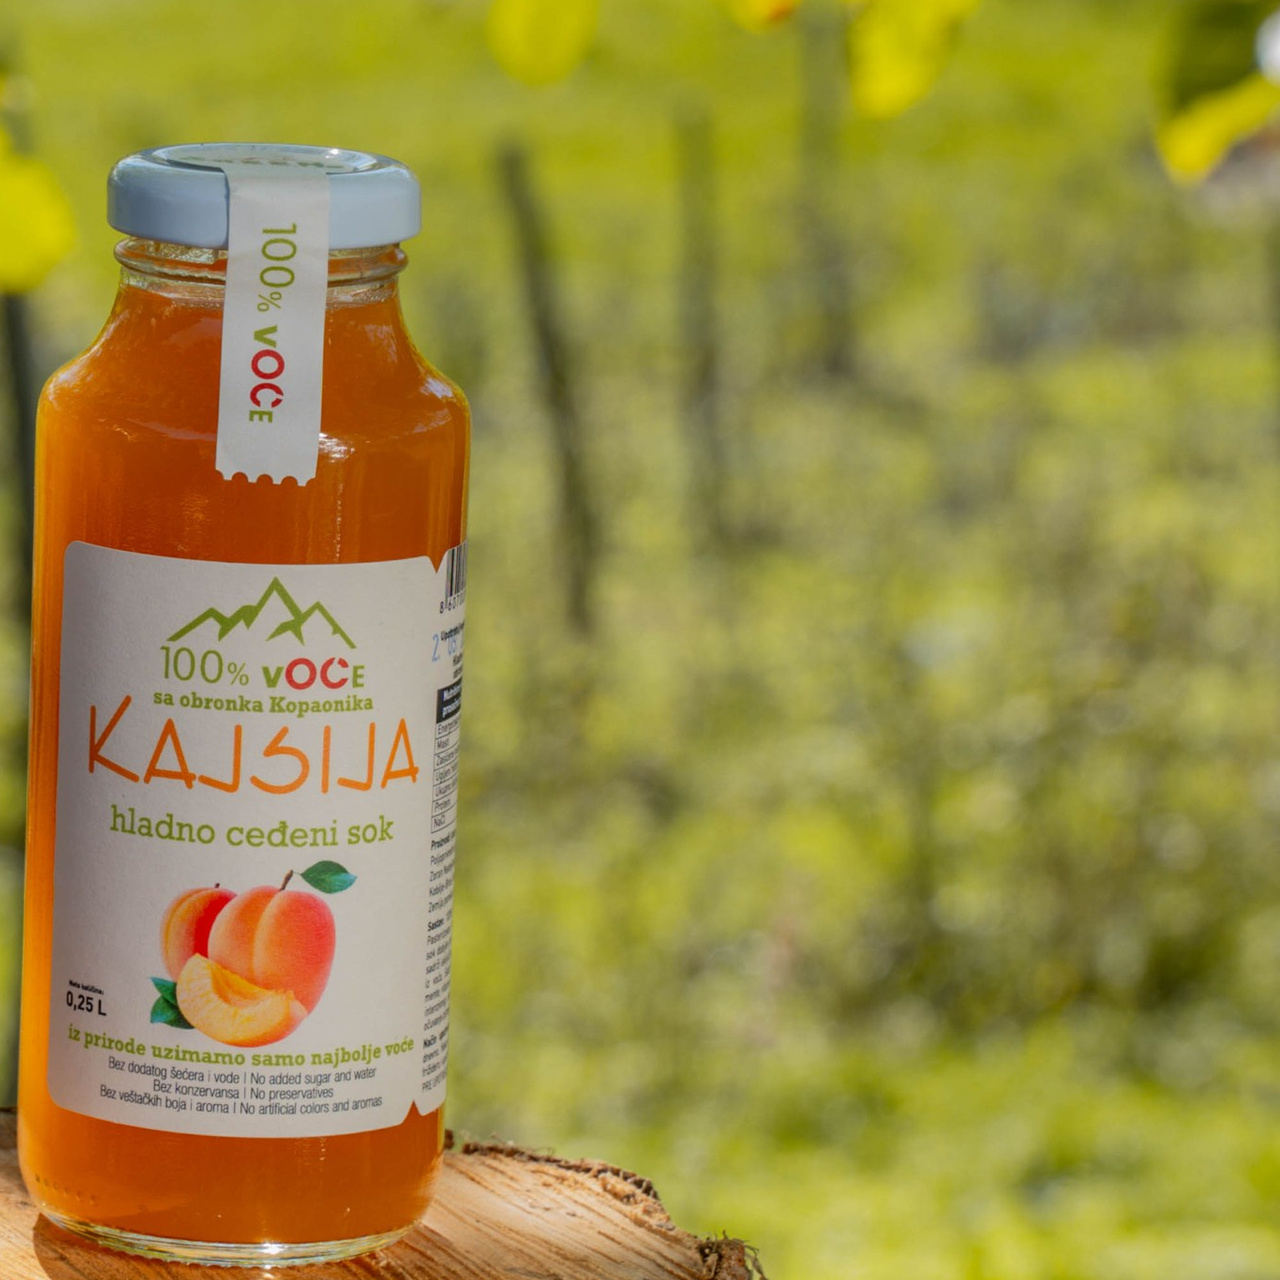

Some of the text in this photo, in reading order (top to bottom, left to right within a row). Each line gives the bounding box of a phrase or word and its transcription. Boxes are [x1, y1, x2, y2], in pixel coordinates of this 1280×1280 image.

[256, 222, 298, 312] 100%
[160, 646, 249, 686] 100%
[154, 692, 374, 718] sa obronka Kopaonika
[87, 695, 420, 795] KAJSIJA
[110, 805, 394, 847] hladno ceđeni sok
[66, 990, 107, 1016] 0,25 L
[68, 1024, 81, 1041] iz
[84, 1032, 147, 1056] prirode
[151, 1044, 246, 1066] uzimamo
[251, 1053, 306, 1067] samo
[311, 1045, 382, 1069] najbolje
[384, 1036, 415, 1057] voće
[108, 1056, 125, 1071] Bez
[128, 1061, 167, 1080] dodatog
[170, 1066, 204, 1082] šećera
[214, 1071, 240, 1084] vode
[250, 1073, 266, 1085] No
[269, 1071, 302, 1085] added
[304, 1071, 331, 1087] sugar
[334, 1069, 352, 1082] and
[354, 1067, 377, 1080] water
[100, 1084, 116, 1099] Bez
[119, 1089, 162, 1107] veštačkih
[165, 1096, 187, 1112] boja
[196, 1100, 229, 1114] aroma
[240, 1102, 255, 1115] No
[259, 1102, 297, 1115] artificial
[300, 1100, 329, 1114] colors
[332, 1098, 350, 1112] and
[352, 1095, 383, 1111] aromas
[153, 1080, 334, 1102] Bez konzervansa No preservatives
